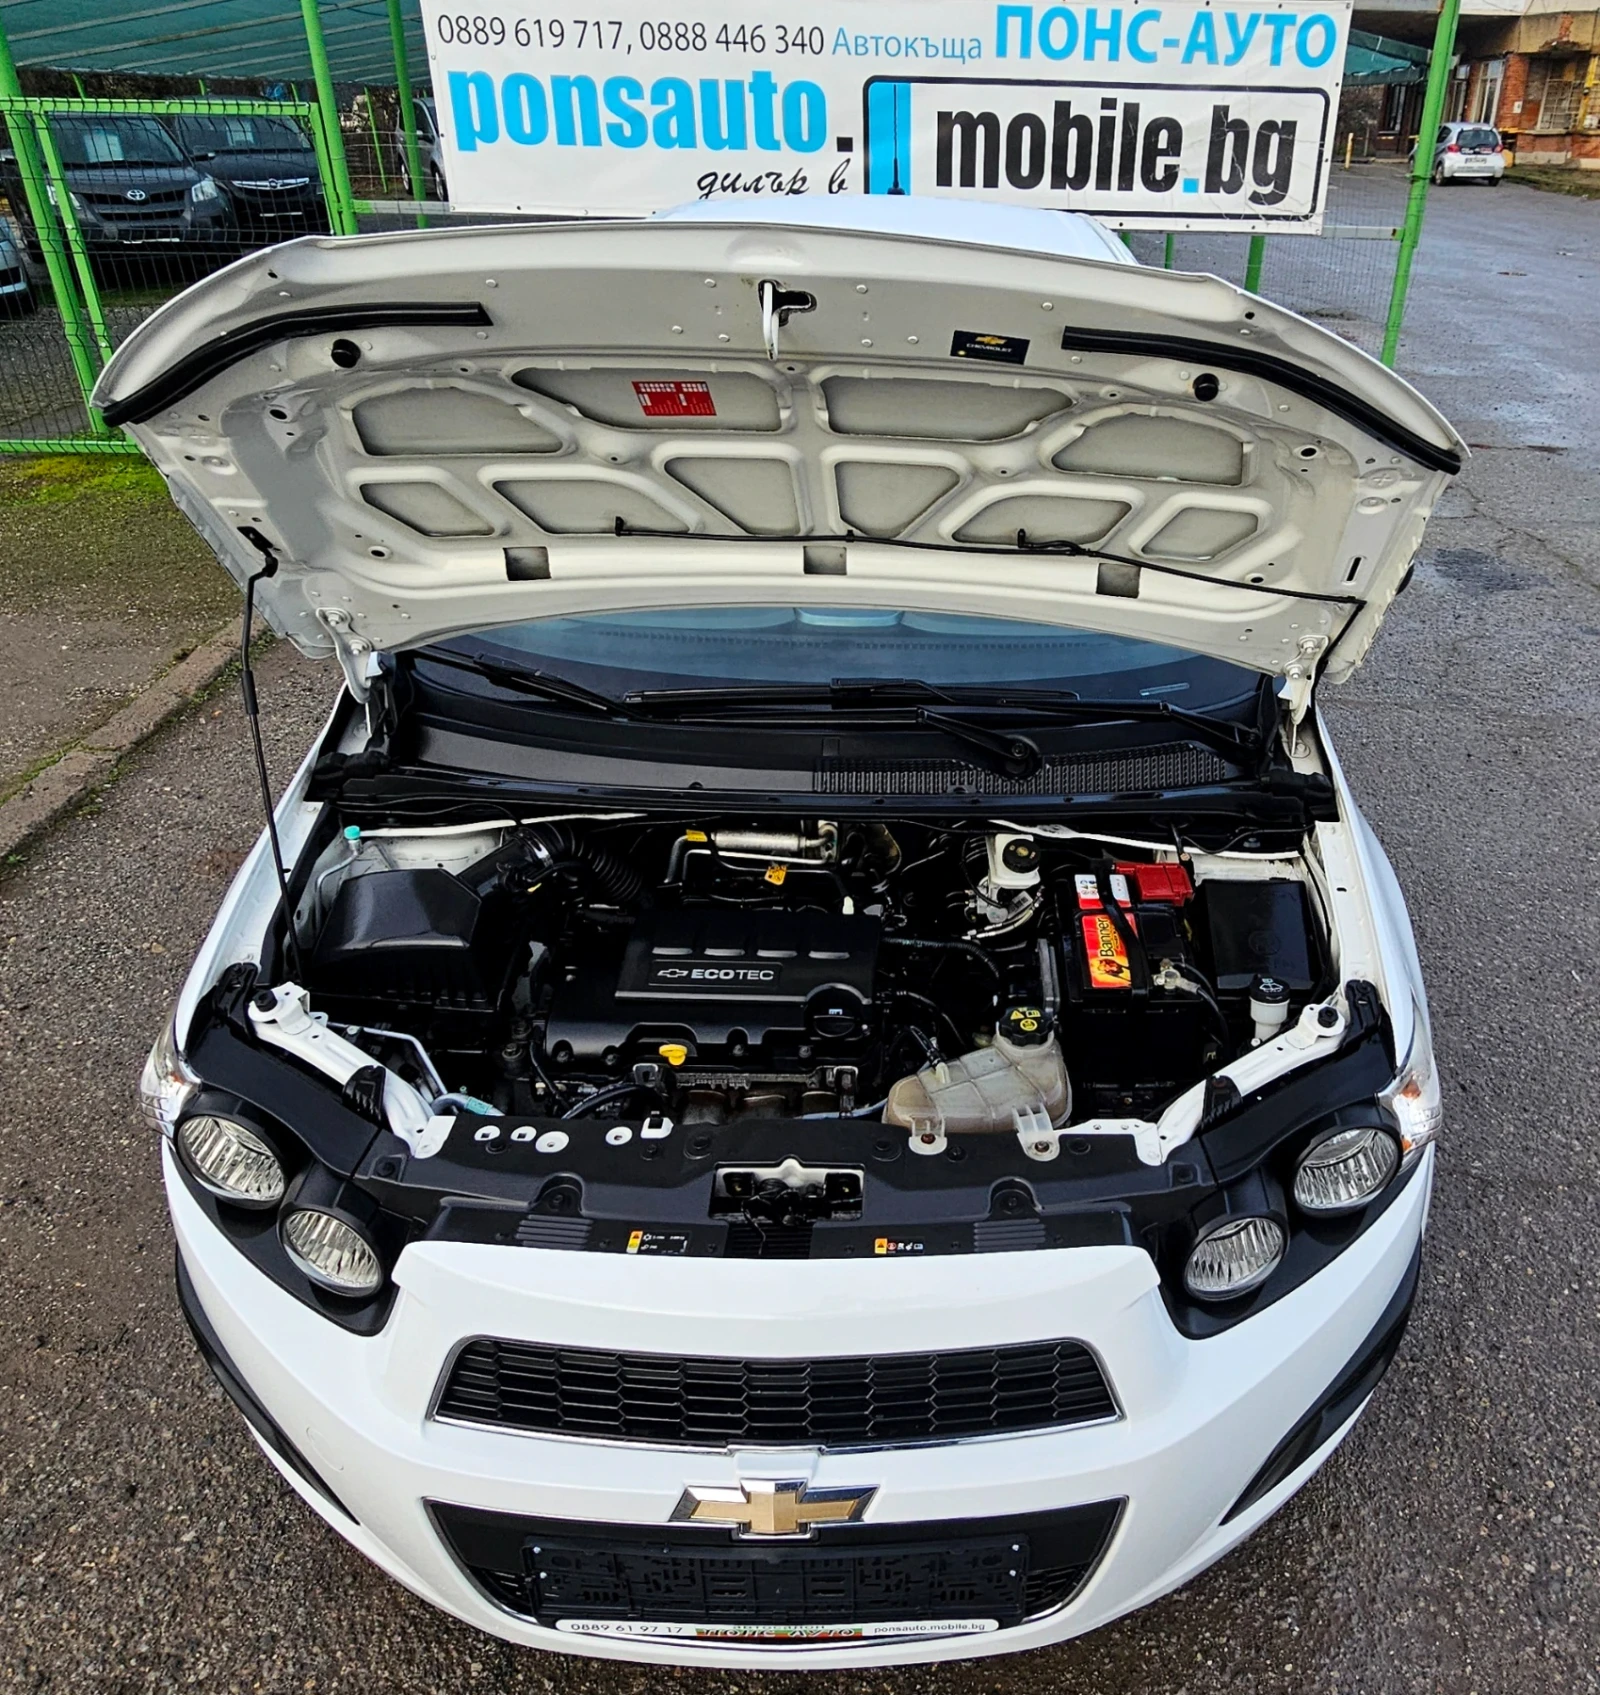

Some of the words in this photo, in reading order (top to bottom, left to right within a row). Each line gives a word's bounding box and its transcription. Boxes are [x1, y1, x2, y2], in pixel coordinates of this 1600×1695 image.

[437, 14, 506, 46] 0889
[514, 18, 565, 49] 619
[573, 19, 633, 55] 717,
[639, 21, 707, 52] 0888
[715, 24, 767, 54] 446
[775, 25, 825, 55] 340
[832, 27, 982, 64] Автокъща
[996, 5, 1337, 68] ПОНС-АУТО
[936, 97, 1298, 206] mobile.bg
[697, 167, 809, 200] дилър
[966, 343, 1012, 352] CHEVROLET
[1097, 917, 1115, 957] Banner
[691, 968, 775, 981] ECOTEC
[571, 1623, 610, 1631] 0889
[615, 1624, 633, 1632] 61
[640, 1625, 658, 1633] 97
[666, 1626, 683, 1634] 17
[874, 1622, 986, 1634] ponsauto.mobile.bg
